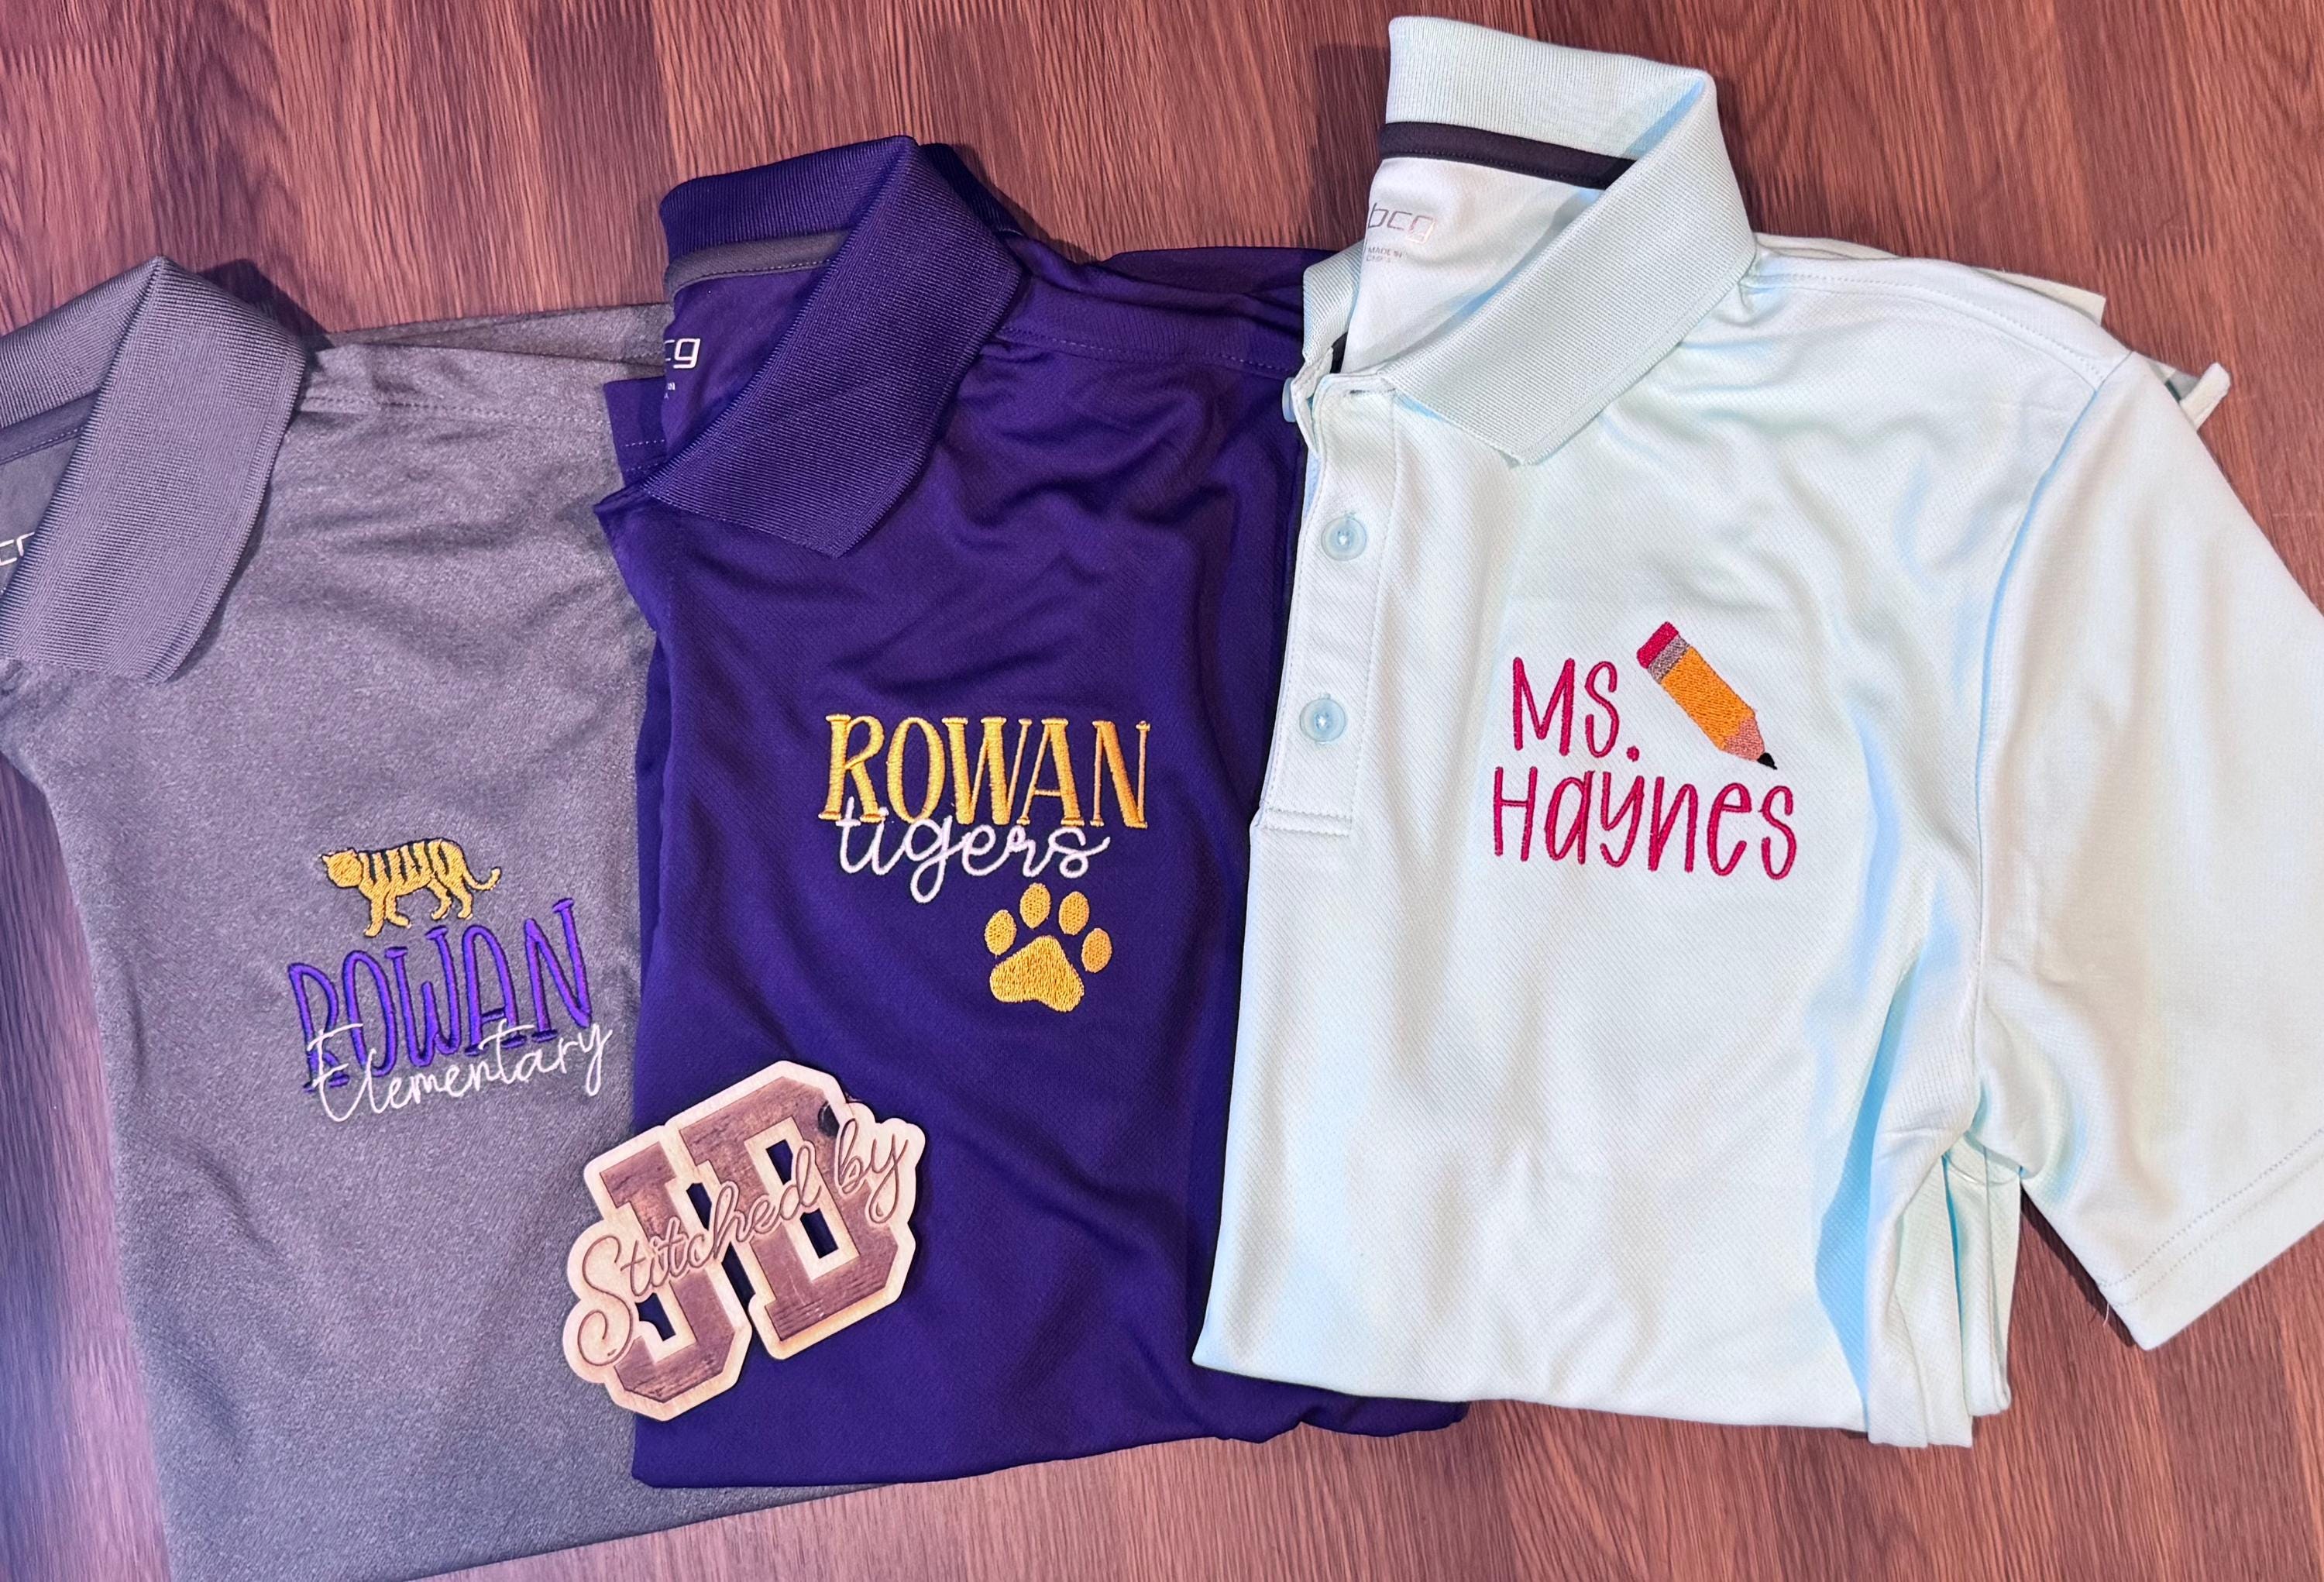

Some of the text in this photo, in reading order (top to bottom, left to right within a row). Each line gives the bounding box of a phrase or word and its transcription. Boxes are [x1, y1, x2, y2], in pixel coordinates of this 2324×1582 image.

[818, 713, 1150, 829] ROWAN
[1493, 765, 1797, 881] Haynes
[835, 796, 1111, 904] tigers
[287, 897, 593, 1092] ROWAN
[307, 1019, 614, 1123] Elementary
[576, 1117, 909, 1367] Stitched by
